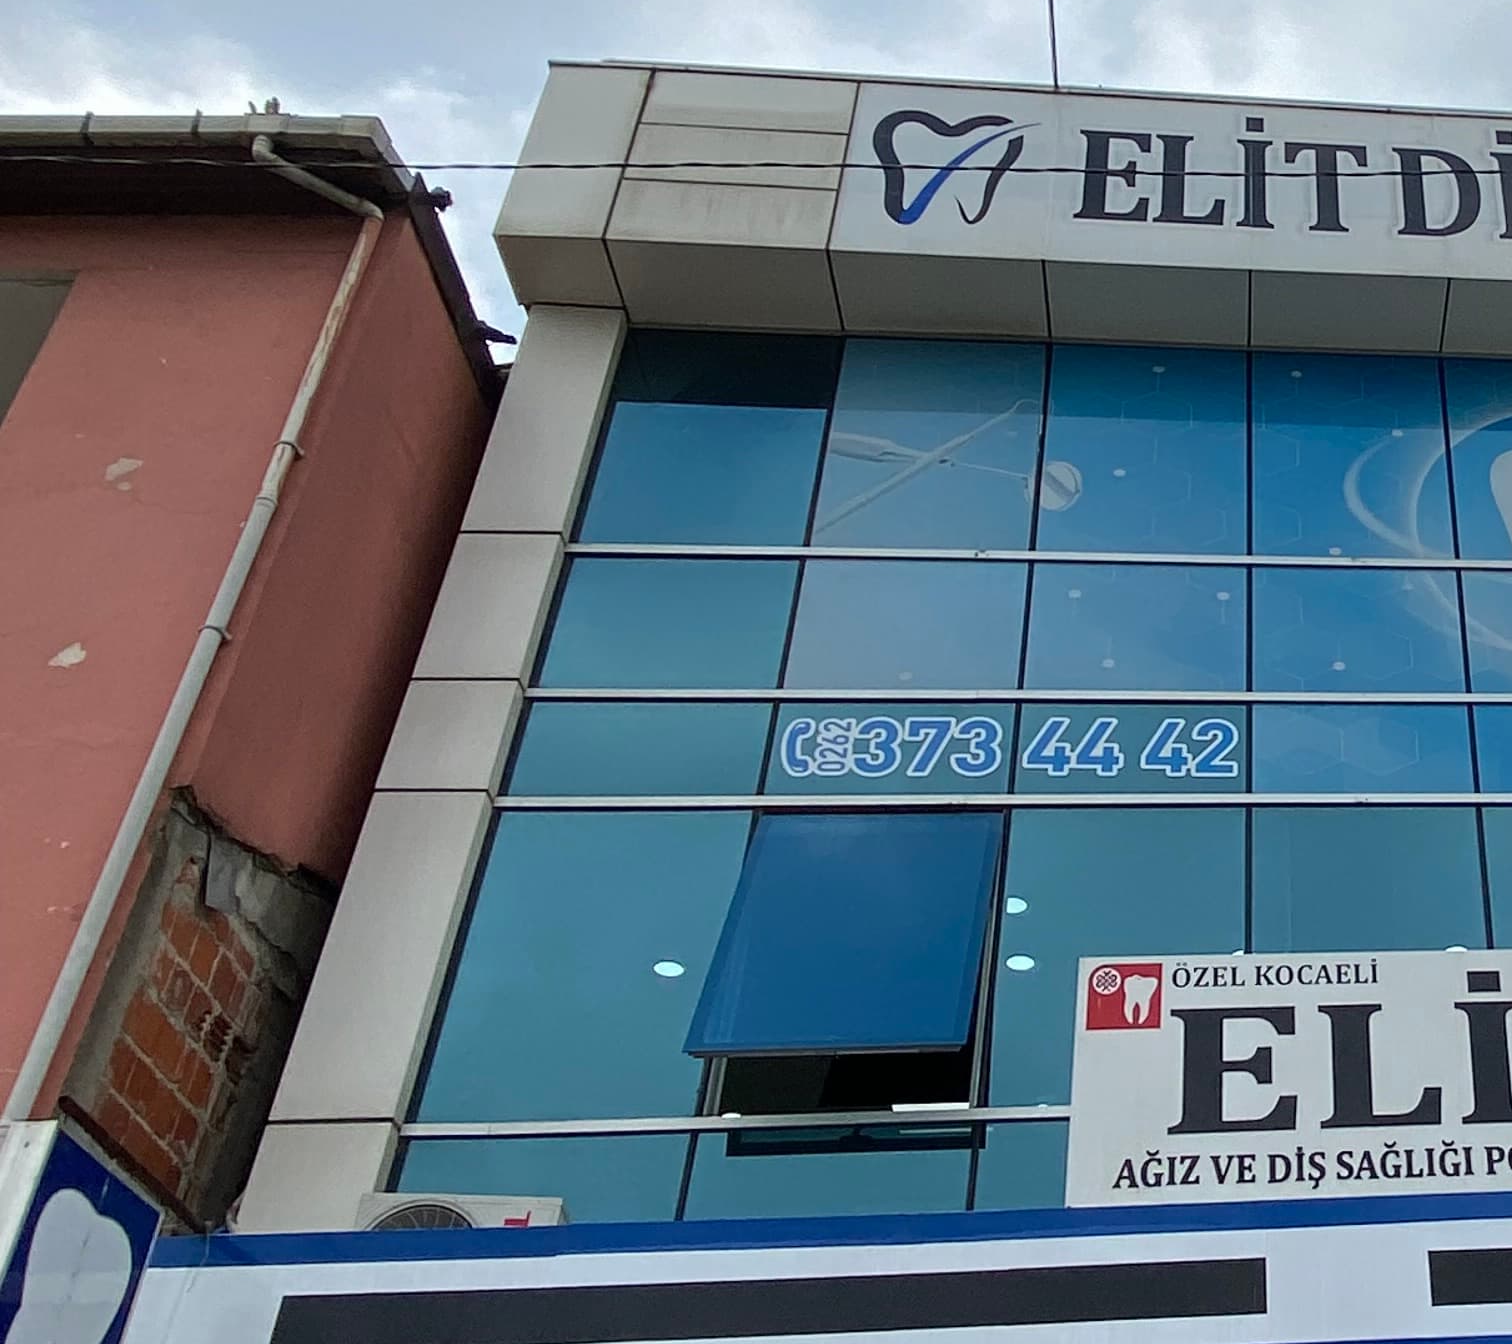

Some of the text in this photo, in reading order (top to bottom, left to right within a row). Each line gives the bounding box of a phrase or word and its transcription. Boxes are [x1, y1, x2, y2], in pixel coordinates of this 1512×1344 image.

[1072, 116, 1368, 233] ELİT
[817, 716, 1239, 778] 0262 373 44 42
[1171, 958, 1380, 989] ÖZEL KOCAELİ
[1112, 1153, 1201, 1190] AĞIZ
[1210, 1154, 1257, 1185] VE
[1267, 1146, 1328, 1191] DİŞ
[1336, 1140, 1476, 1181] SAĞLIĞI
